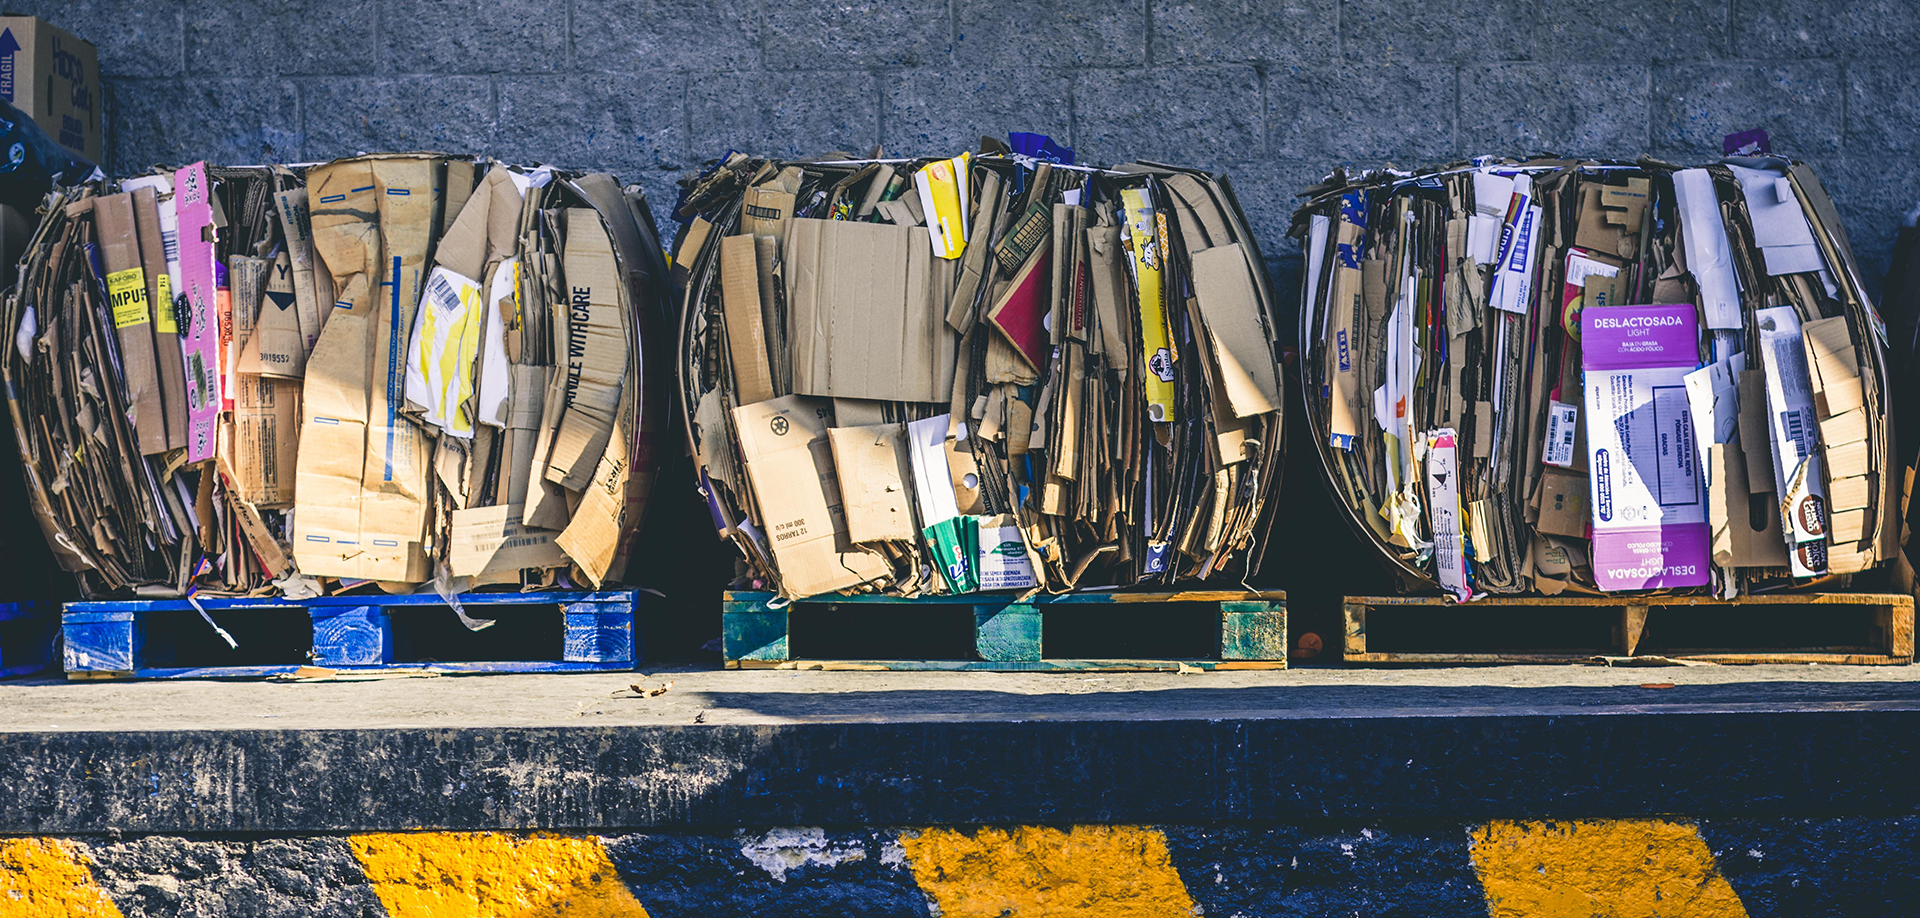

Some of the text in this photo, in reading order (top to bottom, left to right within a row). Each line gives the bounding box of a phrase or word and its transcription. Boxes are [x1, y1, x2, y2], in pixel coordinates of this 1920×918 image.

[1, 54, 12, 94] FRAGIL
[276, 264, 289, 280] Y
[1594, 315, 1683, 328] DESLACTOSADA
[1627, 329, 1650, 337] LIGHT
[567, 286, 590, 408] ANDLE WITH CARE
[260, 353, 290, 363] 3019552
[1661, 433, 1669, 456] GRACIAS
[793, 518, 805, 527] 300
[776, 526, 808, 542] 12 TARROS
[1640, 557, 1664, 566] LIGHT
[1607, 565, 1696, 579] DESLACTOSADA
